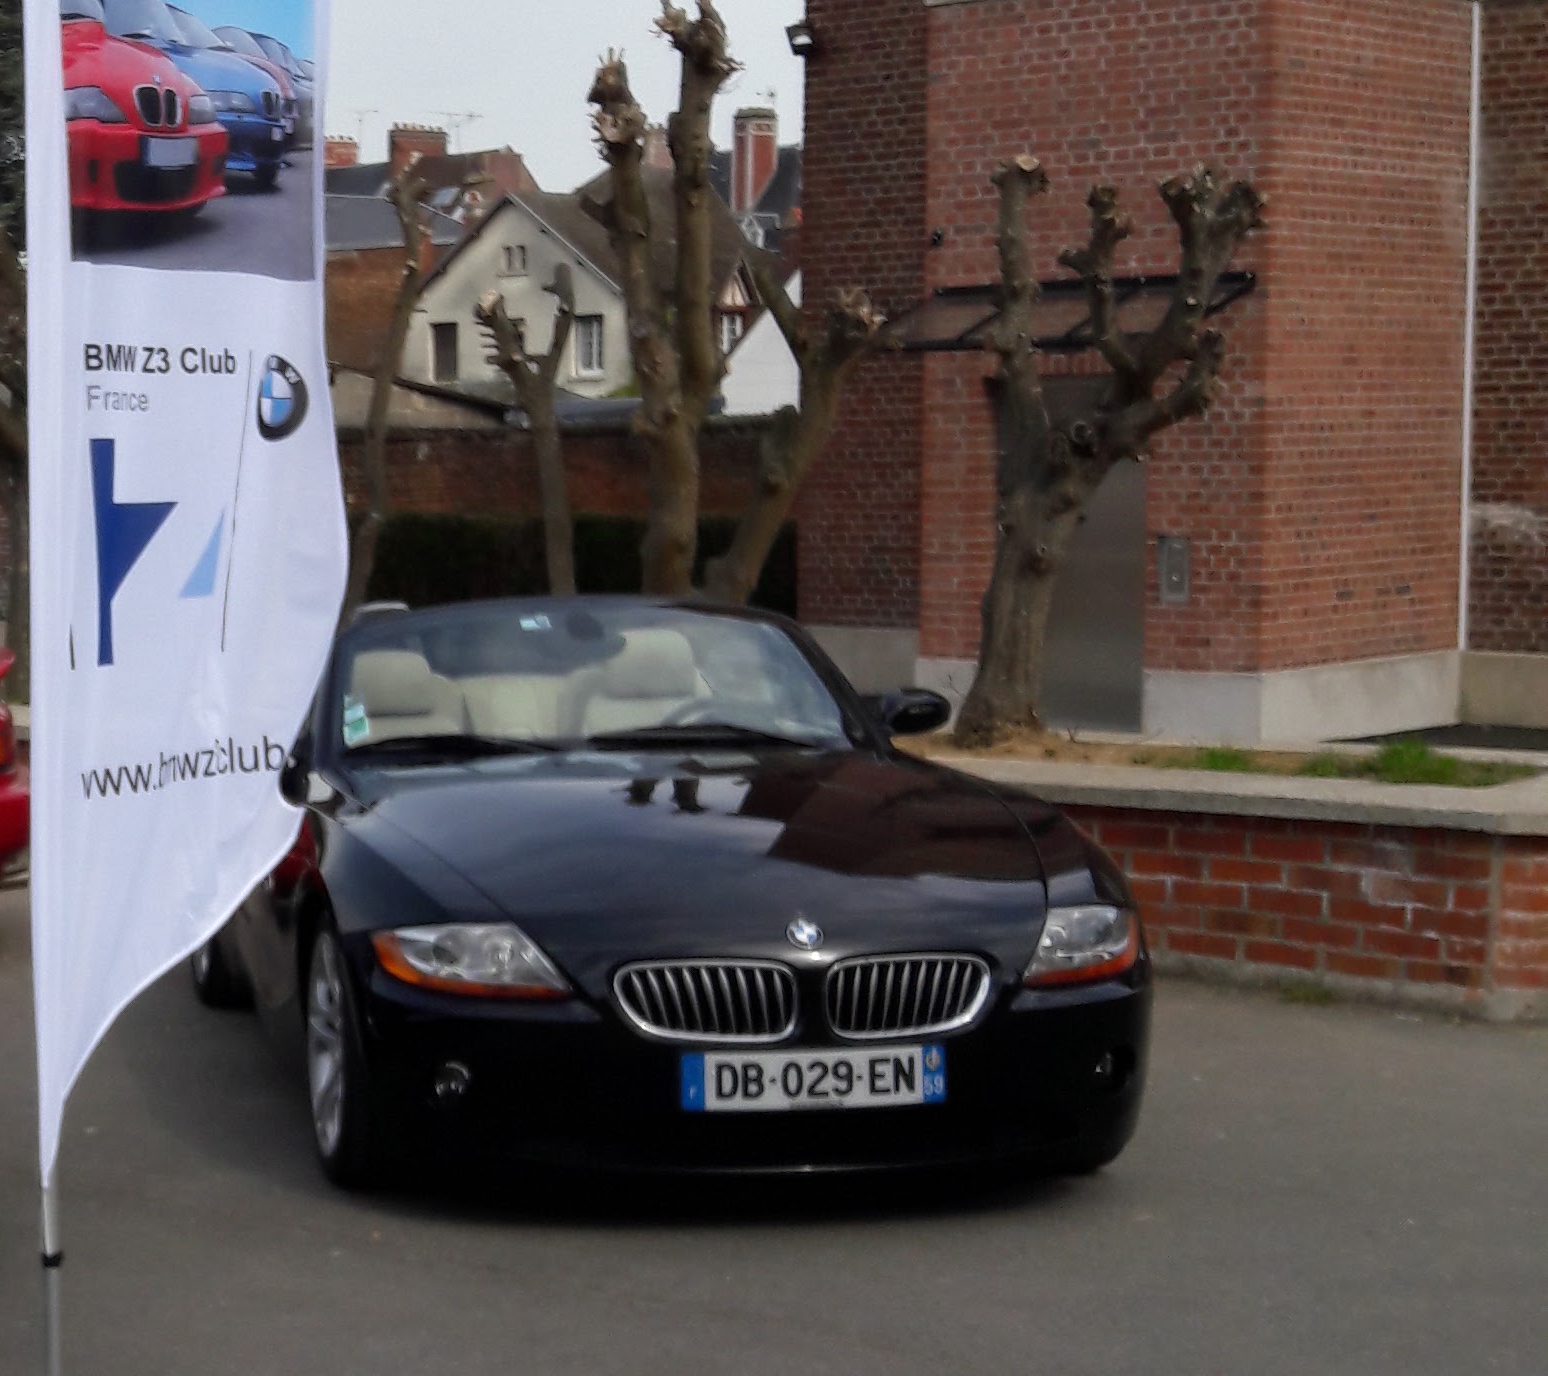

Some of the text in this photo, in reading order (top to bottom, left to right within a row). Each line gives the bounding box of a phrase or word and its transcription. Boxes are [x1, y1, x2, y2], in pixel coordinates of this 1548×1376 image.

[85, 343, 137, 373] BMW
[141, 346, 170, 374] Z3
[180, 346, 236, 374] Club
[86, 385, 149, 412] France
[714, 1056, 916, 1099] DB-029-EN
